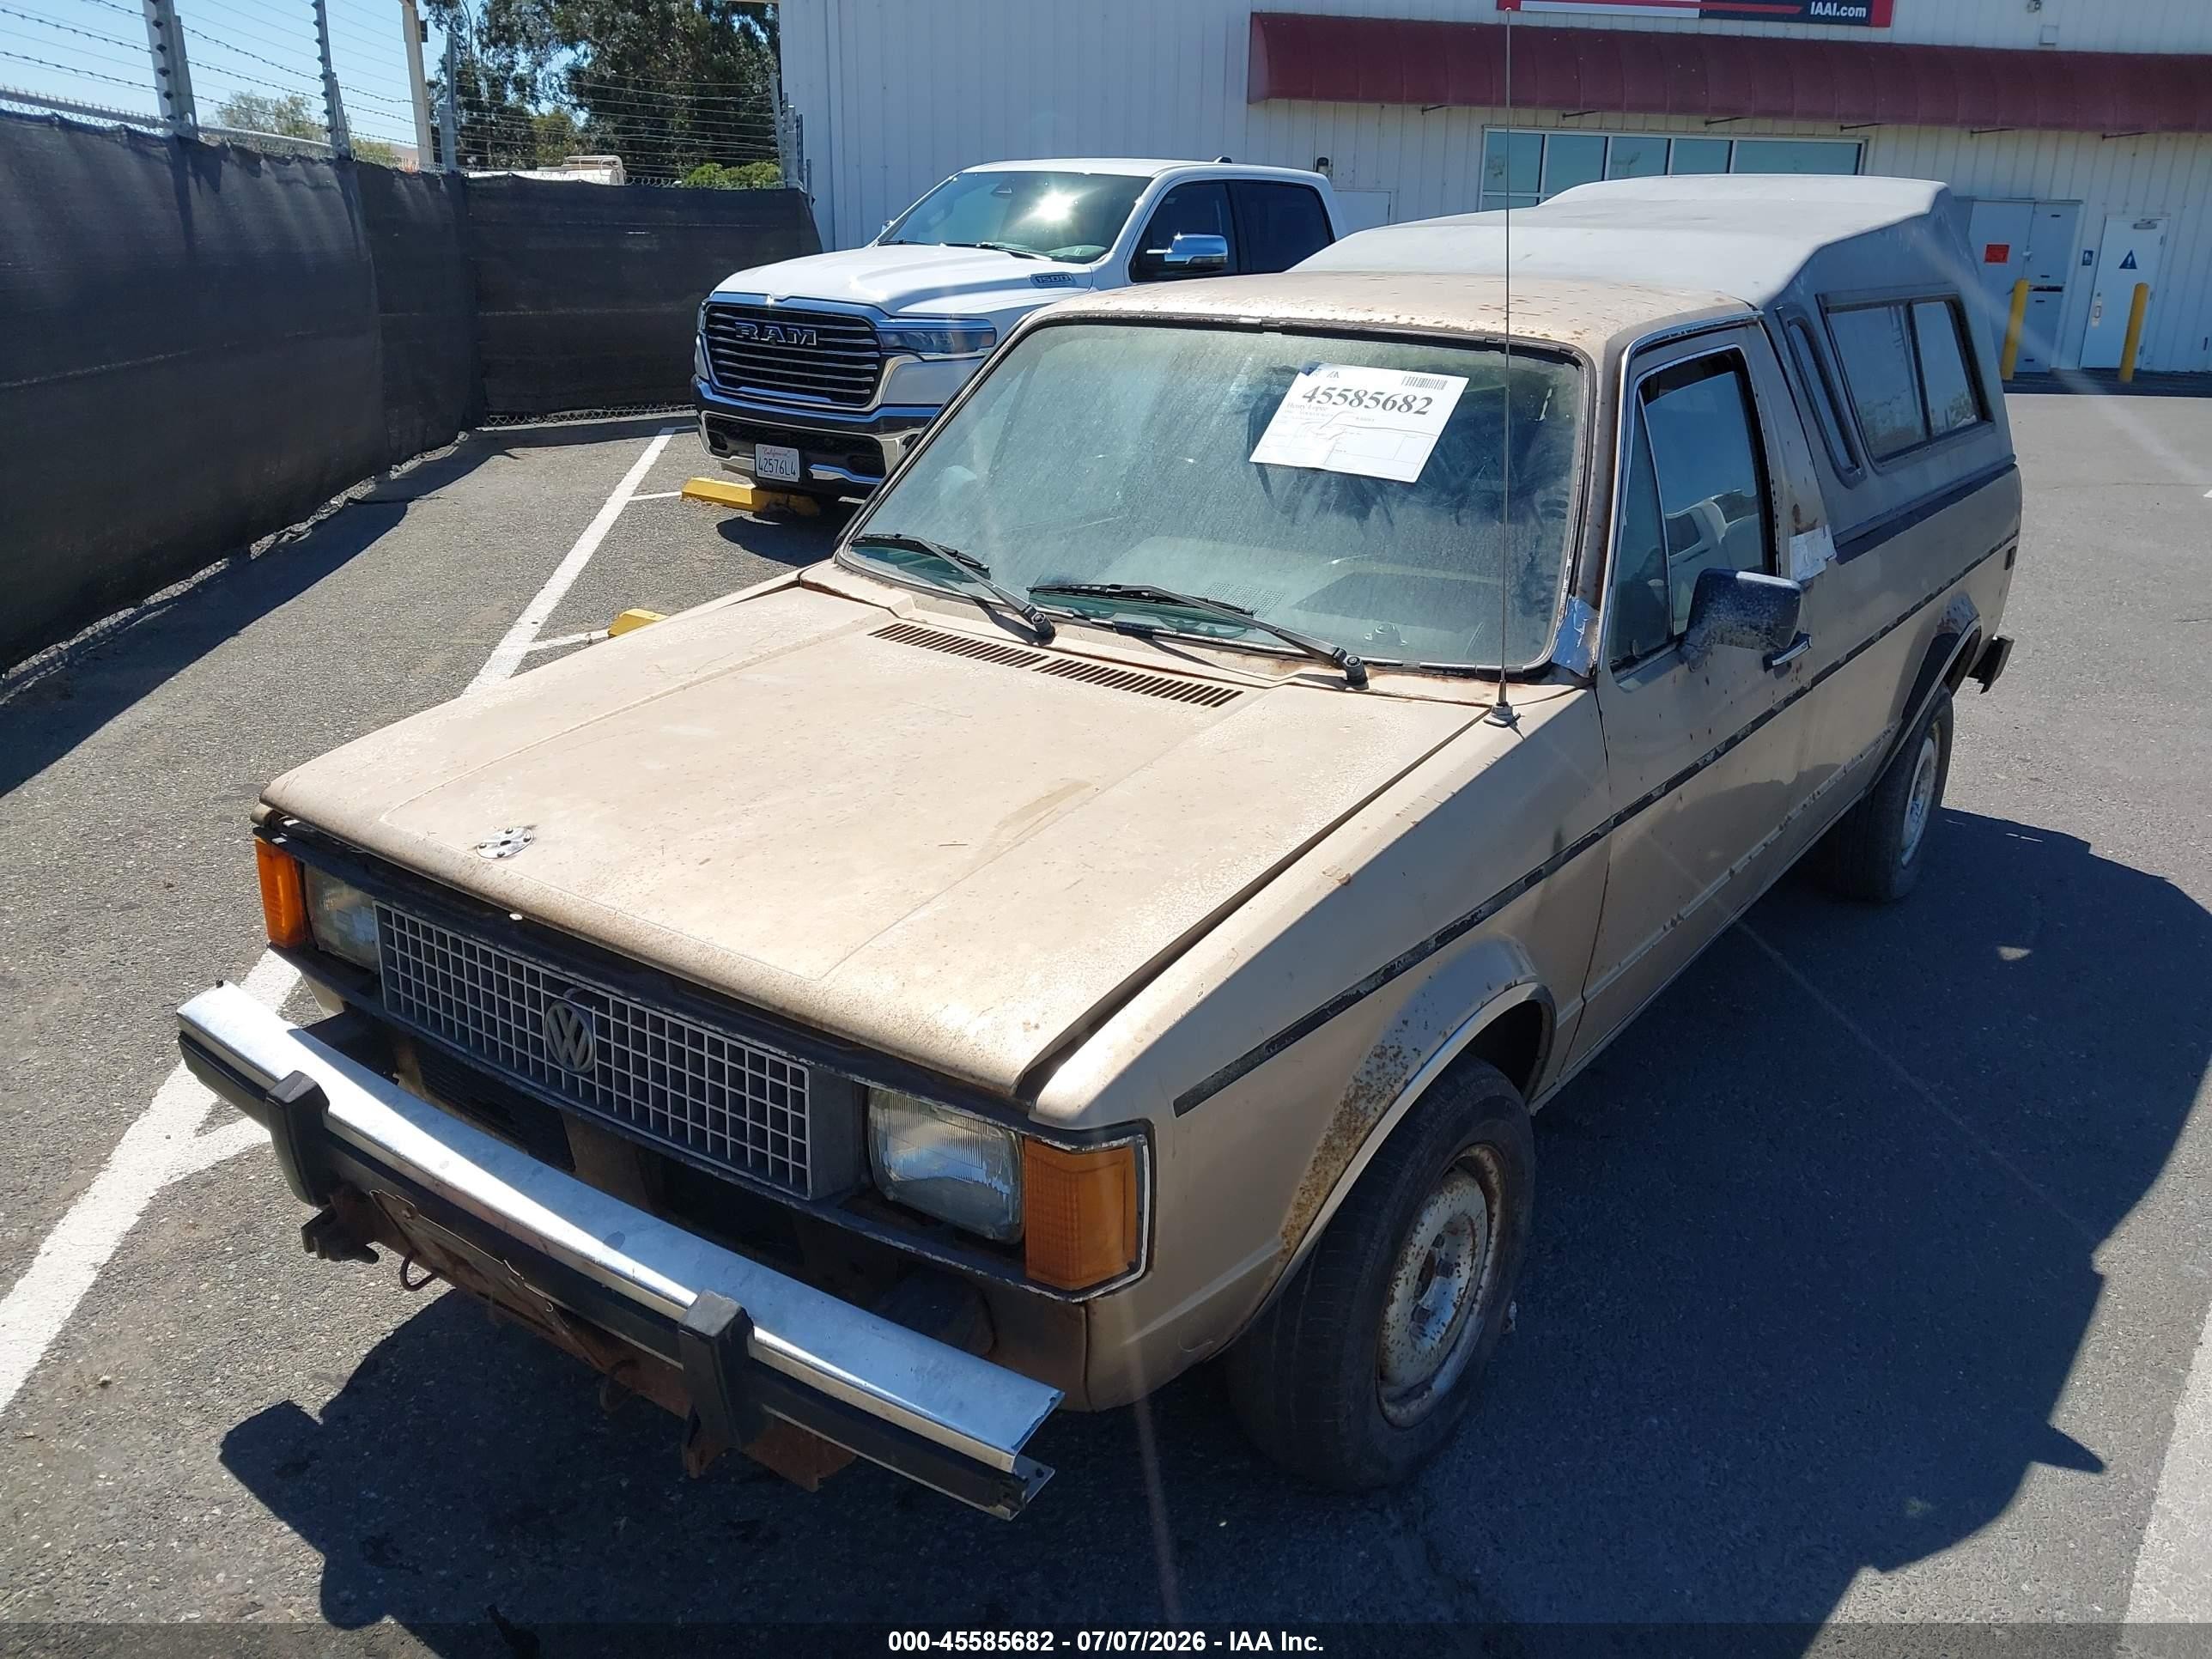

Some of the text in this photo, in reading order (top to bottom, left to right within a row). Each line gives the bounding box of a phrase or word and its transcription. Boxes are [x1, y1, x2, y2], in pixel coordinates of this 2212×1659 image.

[1810, 1, 1867, 18] IAAI.com
[735, 322, 817, 345] RAM
[1302, 385, 1433, 416] 45585682
[758, 455, 796, 476] 42576L4
